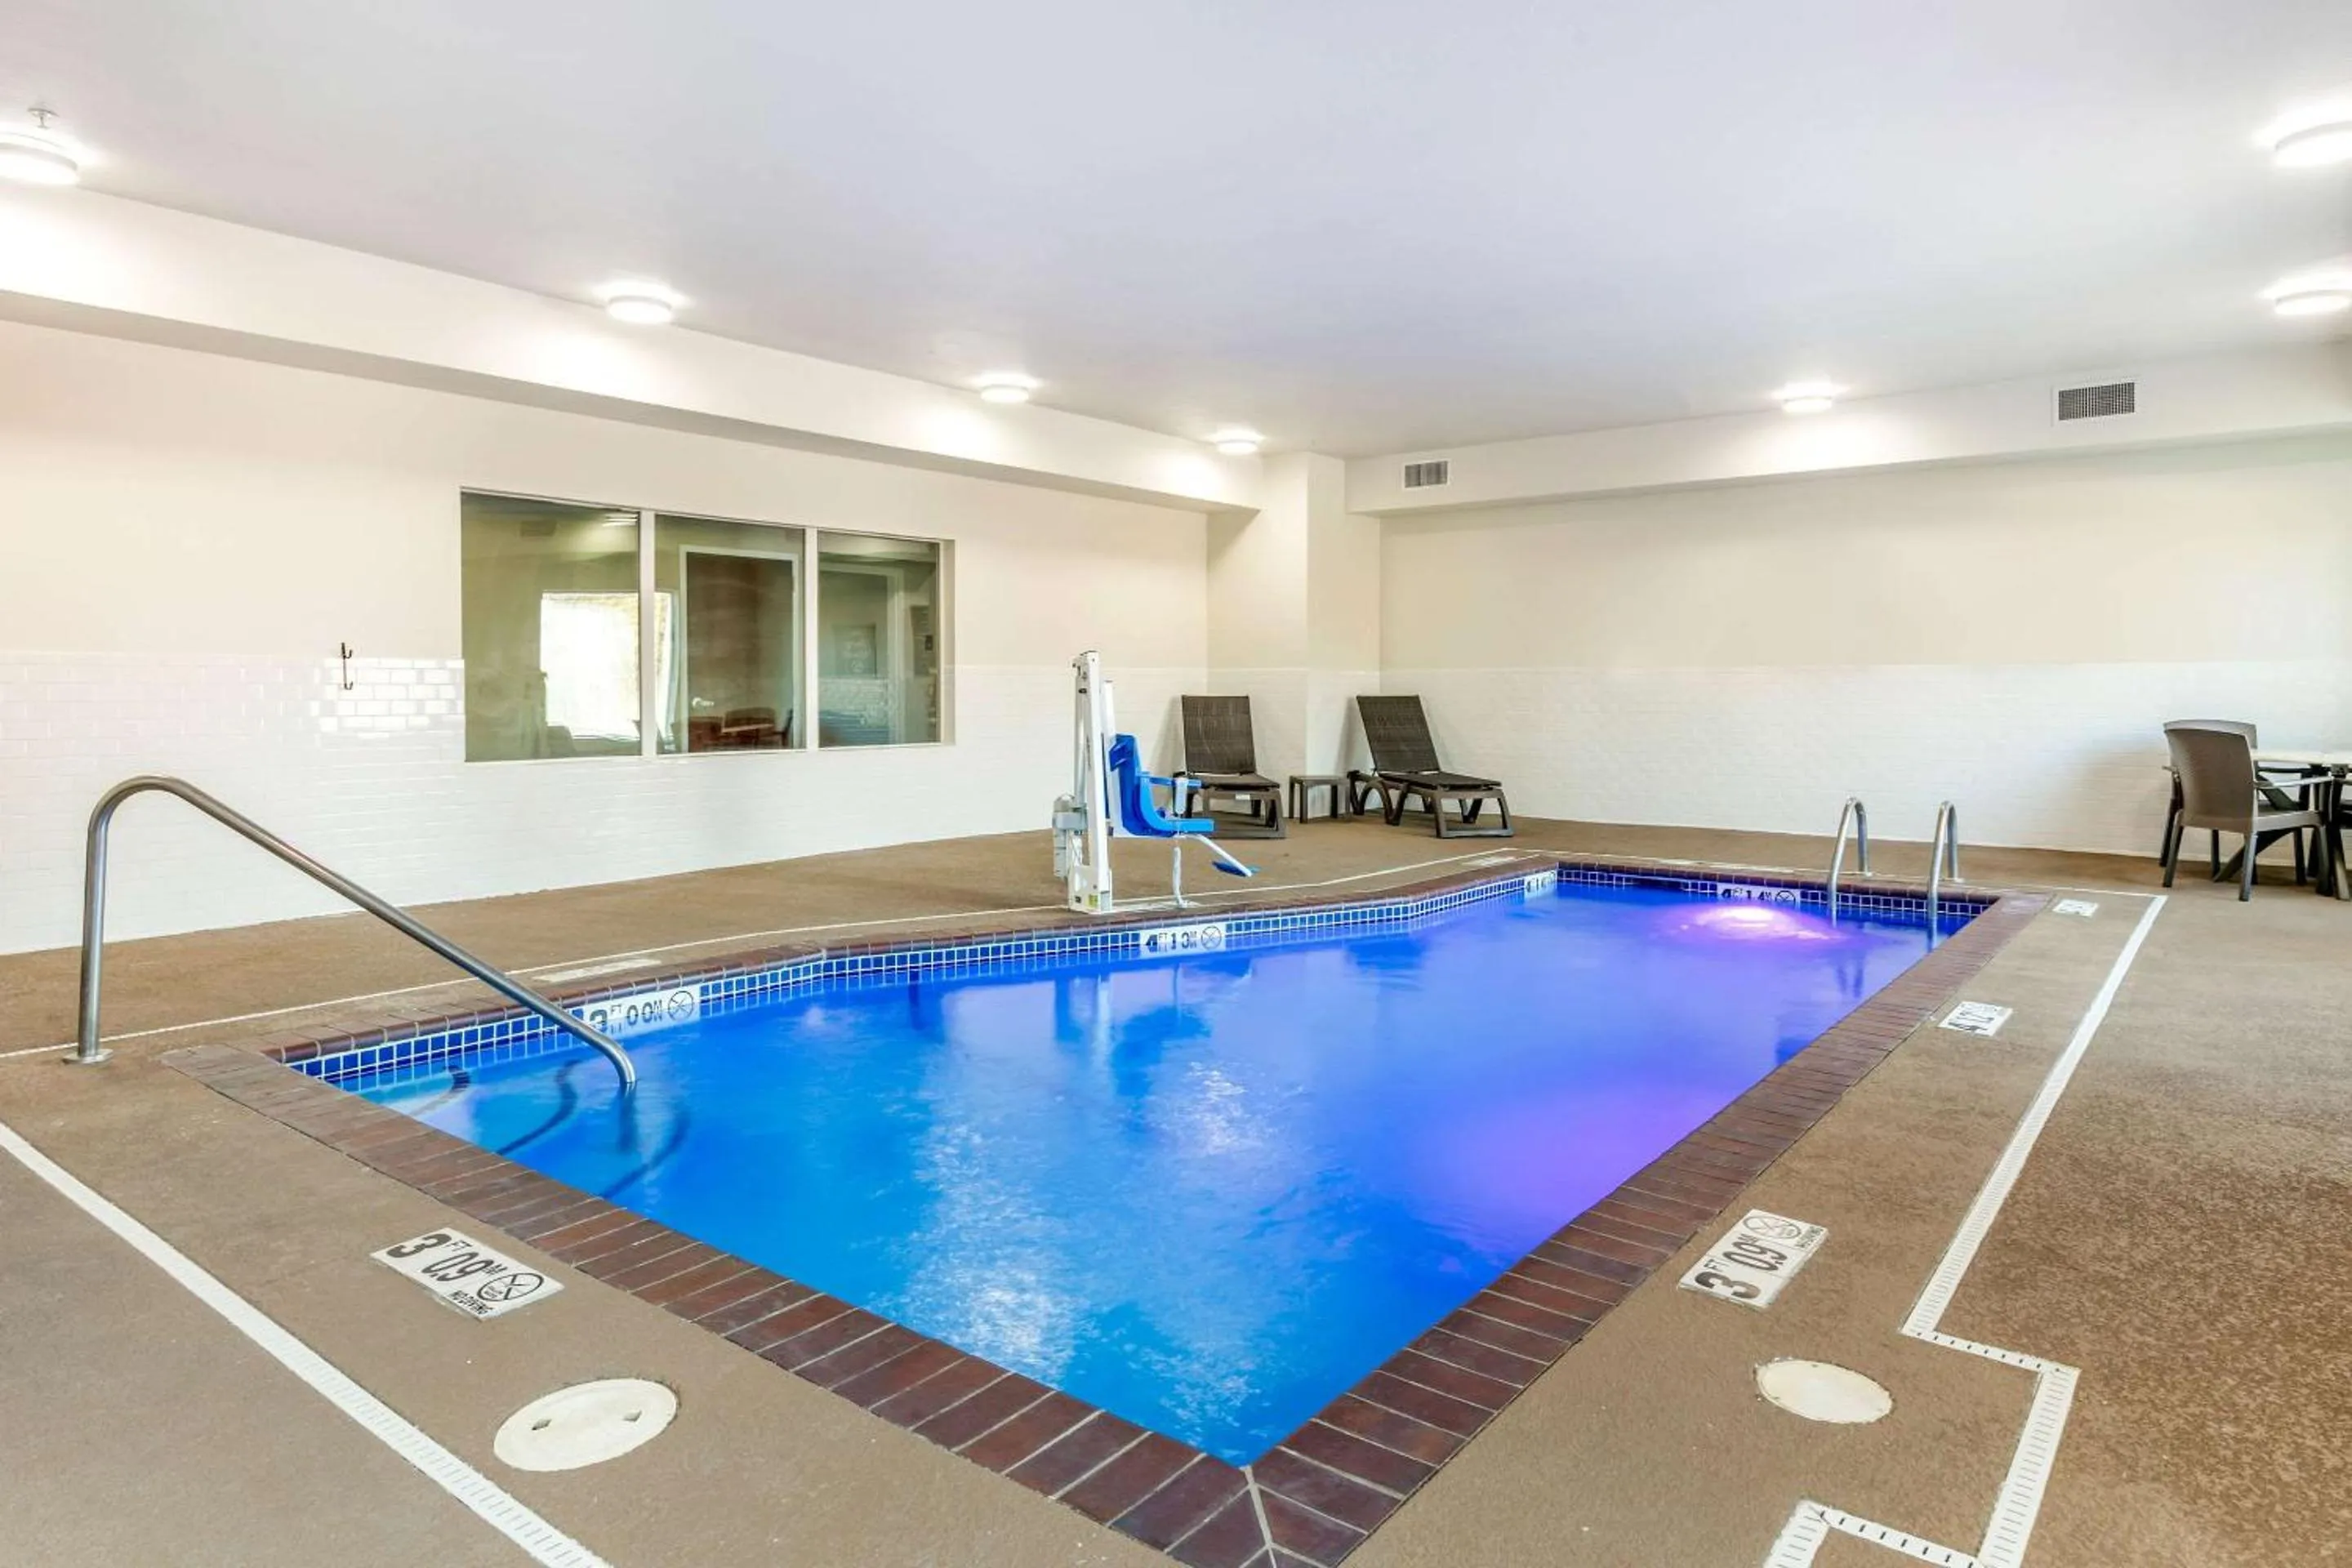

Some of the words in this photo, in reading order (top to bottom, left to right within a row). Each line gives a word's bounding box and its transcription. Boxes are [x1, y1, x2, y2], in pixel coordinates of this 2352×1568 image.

[386, 1233, 452, 1258] 3
[443, 1239, 474, 1253] FT
[1722, 1241, 1788, 1271] 0.9
[421, 1252, 494, 1281] 0.9
[1704, 1258, 1730, 1272] FT
[1695, 1271, 1762, 1299] 3
